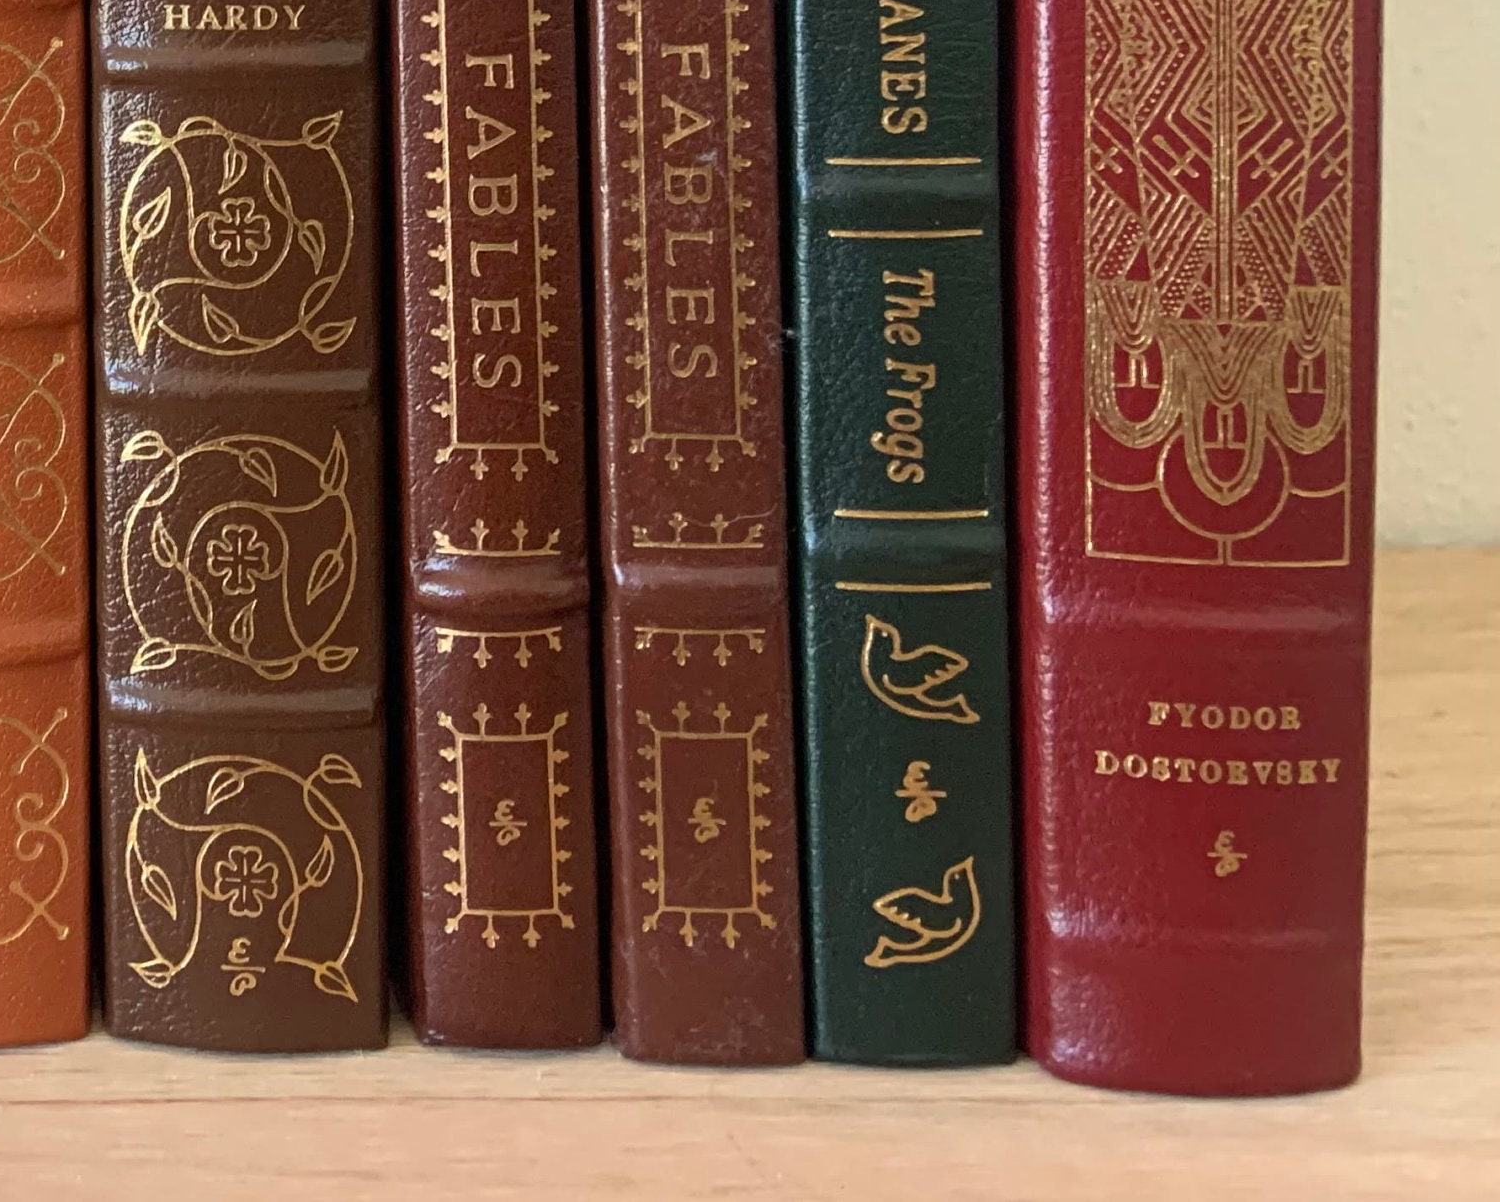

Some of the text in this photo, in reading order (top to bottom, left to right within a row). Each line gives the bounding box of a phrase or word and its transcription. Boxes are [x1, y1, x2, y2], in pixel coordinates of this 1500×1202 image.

[163, 3, 306, 31] HARDY
[465, 53, 522, 389] FABLES
[660, 42, 719, 379] FABLES
[870, 268, 936, 484] The Frogs
[1147, 701, 1301, 731] FYODOR
